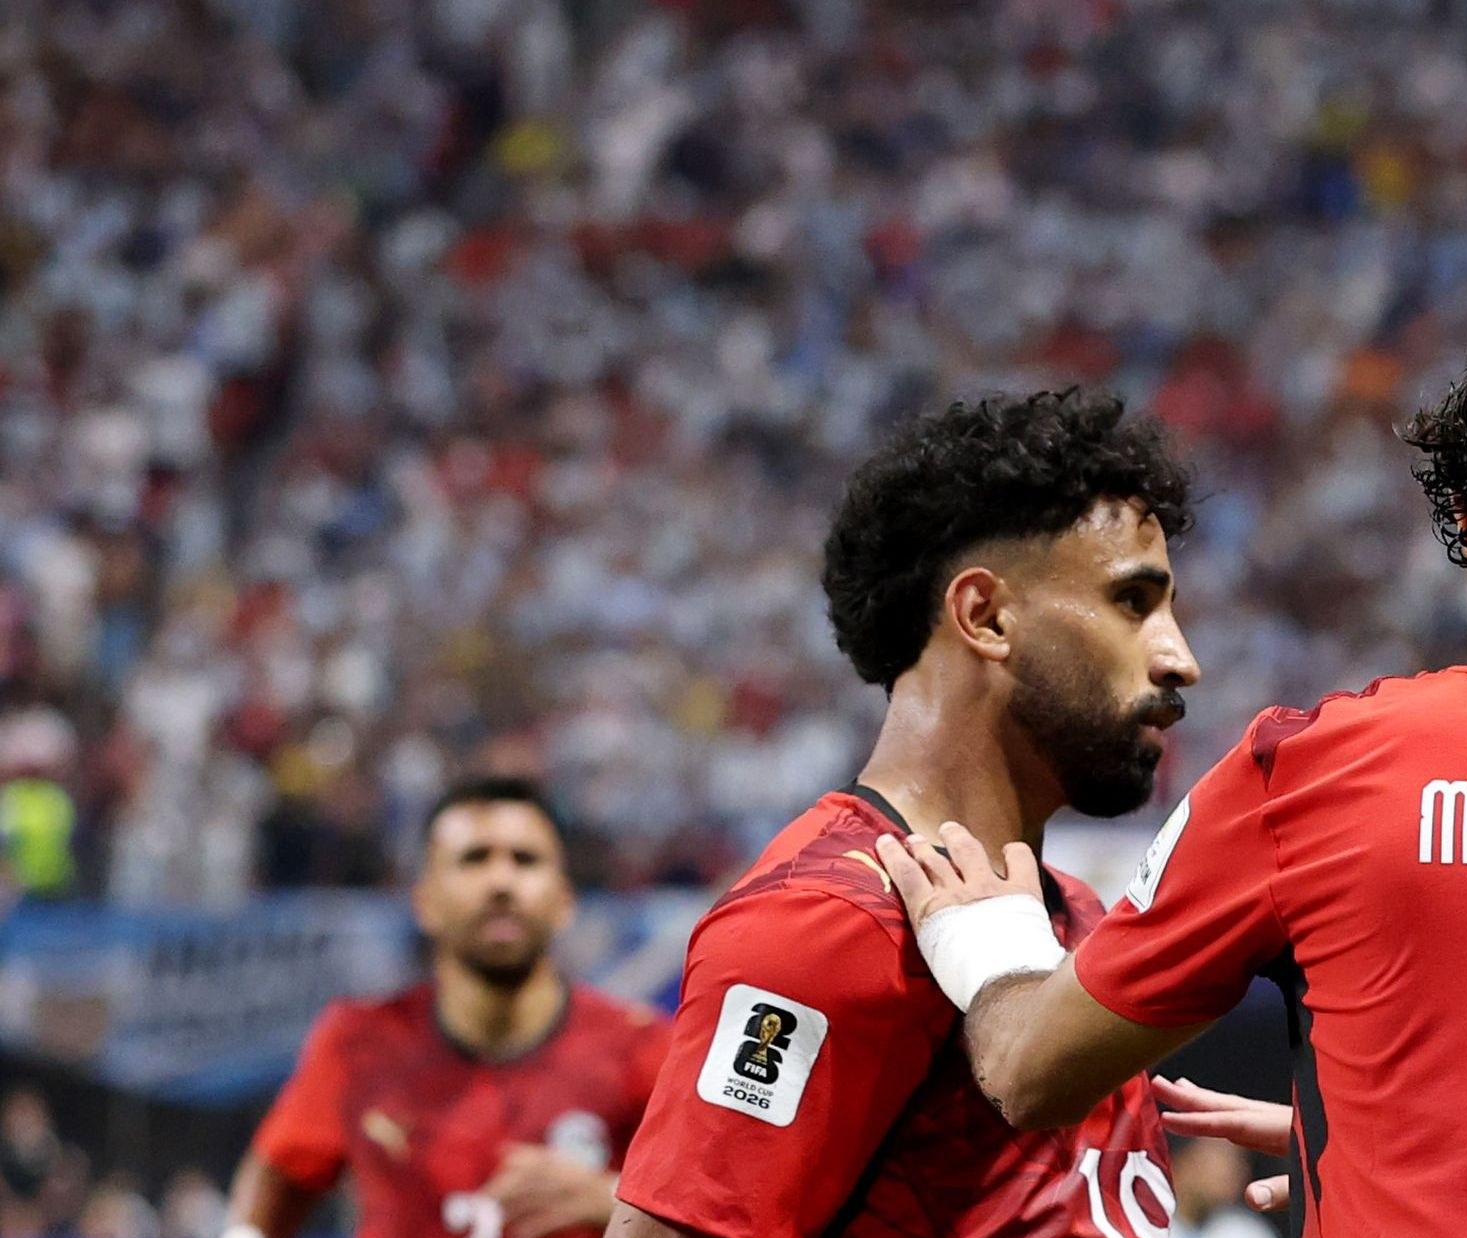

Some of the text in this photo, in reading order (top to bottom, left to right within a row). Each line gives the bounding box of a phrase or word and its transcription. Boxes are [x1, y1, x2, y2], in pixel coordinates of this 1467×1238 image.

[744, 1062, 768, 1077] FIFA
[723, 1086, 770, 1108] 2026
[727, 1077, 774, 1097] WORLD CUP
